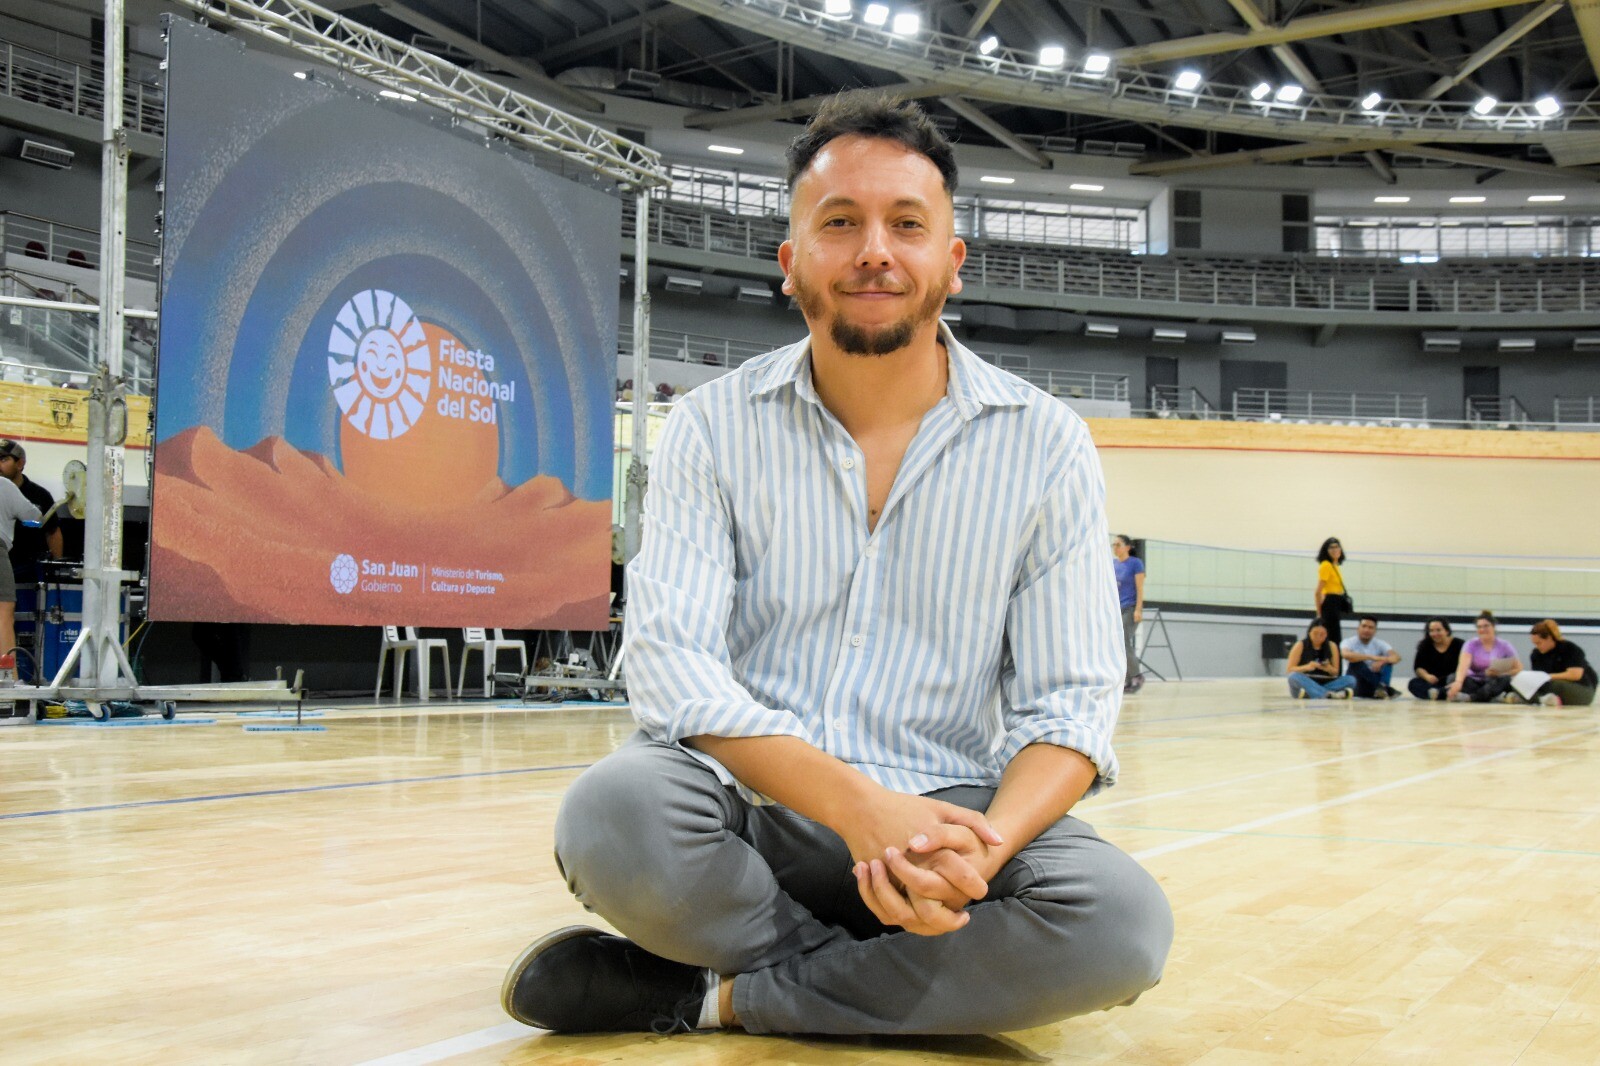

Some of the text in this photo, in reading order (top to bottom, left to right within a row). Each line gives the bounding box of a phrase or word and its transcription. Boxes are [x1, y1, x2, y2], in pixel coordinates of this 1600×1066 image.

[440, 339, 494, 372] Fiesta
[438, 366, 515, 402] Nacional
[437, 394, 496, 424] del Sol
[361, 559, 418, 577] San Juan
[432, 567, 505, 583] Ministerio de Turismo,
[361, 579, 402, 593] Gobierno
[431, 581, 495, 595] Cultura y Deporte
